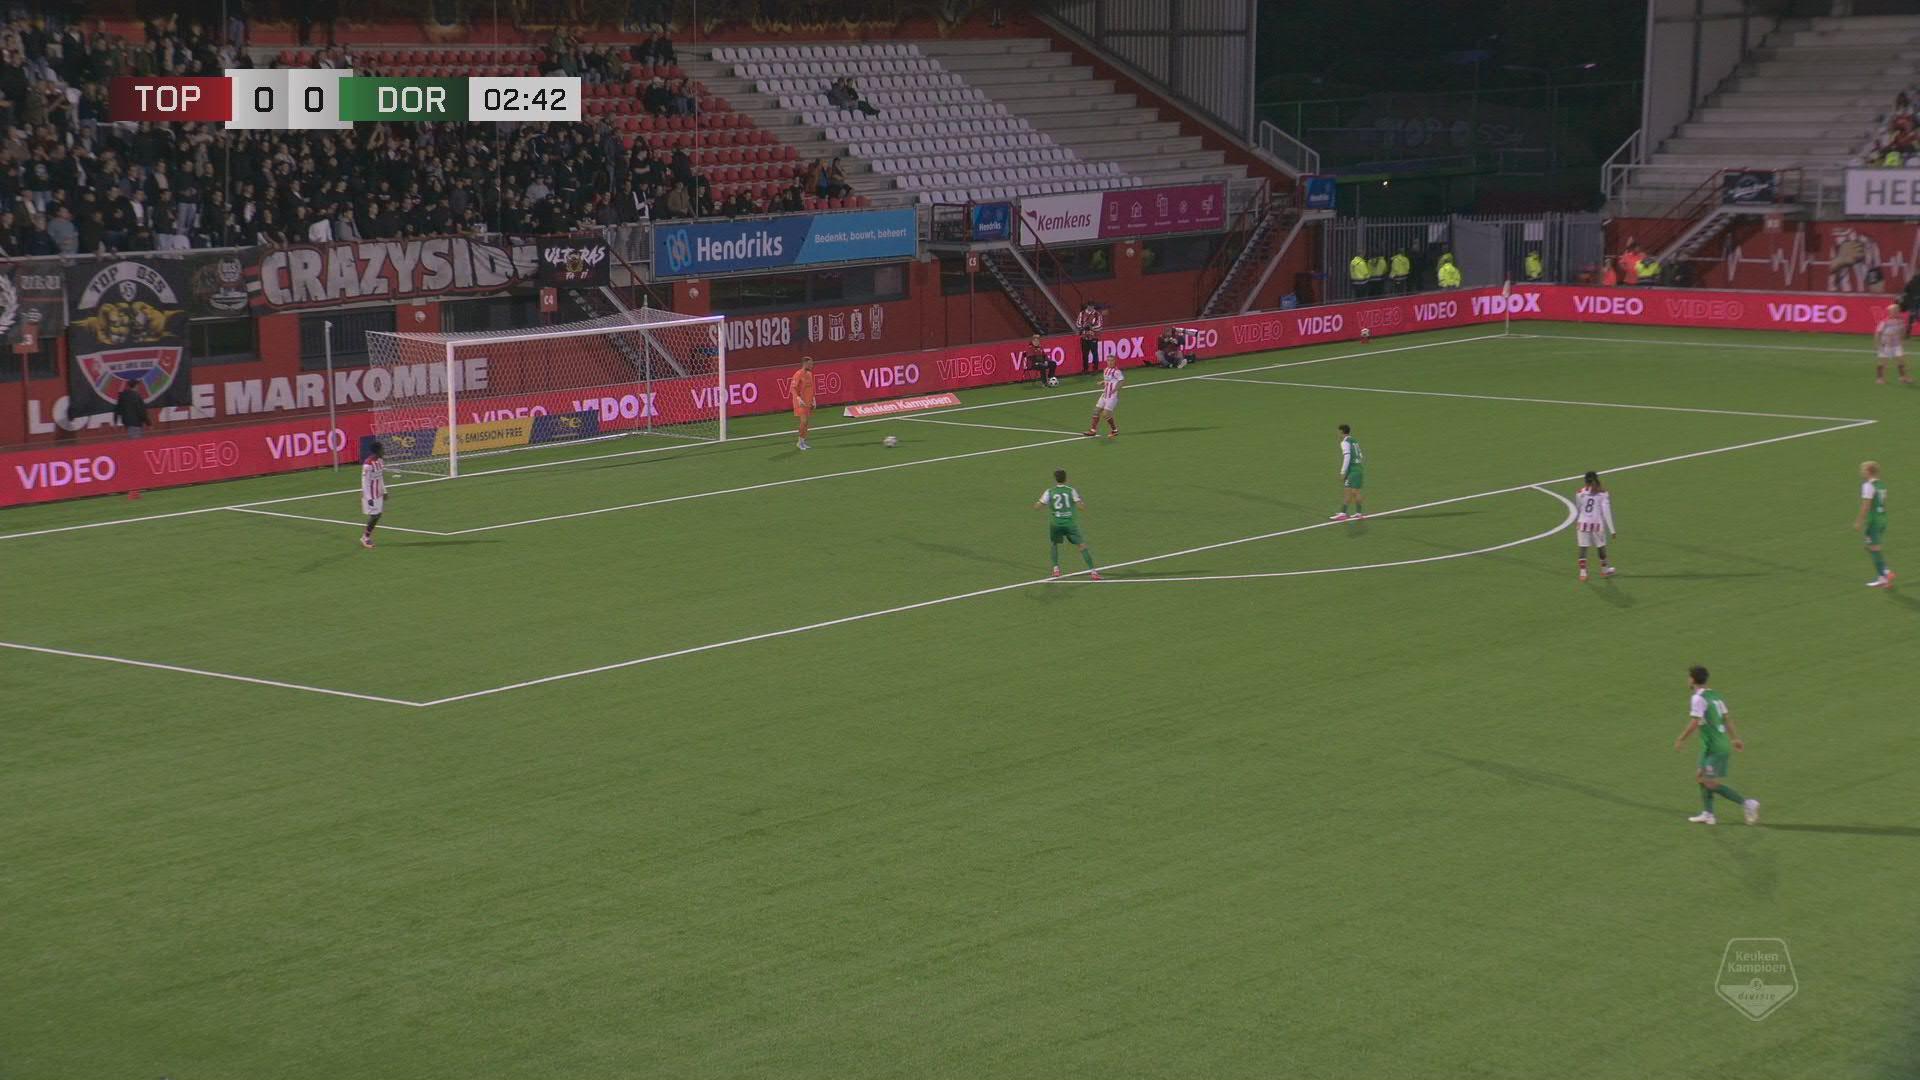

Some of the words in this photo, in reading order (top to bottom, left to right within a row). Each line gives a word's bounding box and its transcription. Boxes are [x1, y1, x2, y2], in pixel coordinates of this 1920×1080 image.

[1037, 210, 1091, 232] Kemkens
[697, 231, 783, 262] Hendriks
[815, 232, 849, 243] Bedenkt,
[850, 229, 876, 241] bouwt,
[878, 228, 907, 238] beheert
[89, 266, 119, 294] TOP
[136, 266, 167, 294] OSS
[1414, 300, 1457, 321] VIDEO
[1472, 292, 1541, 316] VIDOX
[1573, 295, 1643, 316] VIDEO
[1666, 300, 1744, 321] VIDEO
[1768, 303, 1847, 323] VIDEO
[709, 317, 754, 351] SNDS
[756, 316, 791, 347] 1928
[1233, 320, 1283, 344] VIDEO
[1298, 314, 1343, 336] VIDEO
[1088, 336, 1145, 363] IDOX
[1180, 328, 1218, 351] DEO
[861, 363, 920, 389] VIDEO
[937, 354, 997, 381] VIDEO
[225, 373, 325, 415] MAR
[335, 358, 489, 405] KOMME
[691, 383, 758, 409] VIDEO
[778, 372, 842, 399] VEO
[856, 403, 897, 415] Keuken
[897, 395, 952, 409] Kampioen
[266, 428, 347, 459] VIDEO
[144, 441, 239, 475] VIDEO
[16, 455, 116, 489] VIDEO
[1052, 493, 1071, 509] 21
[1585, 498, 1595, 513] 8
